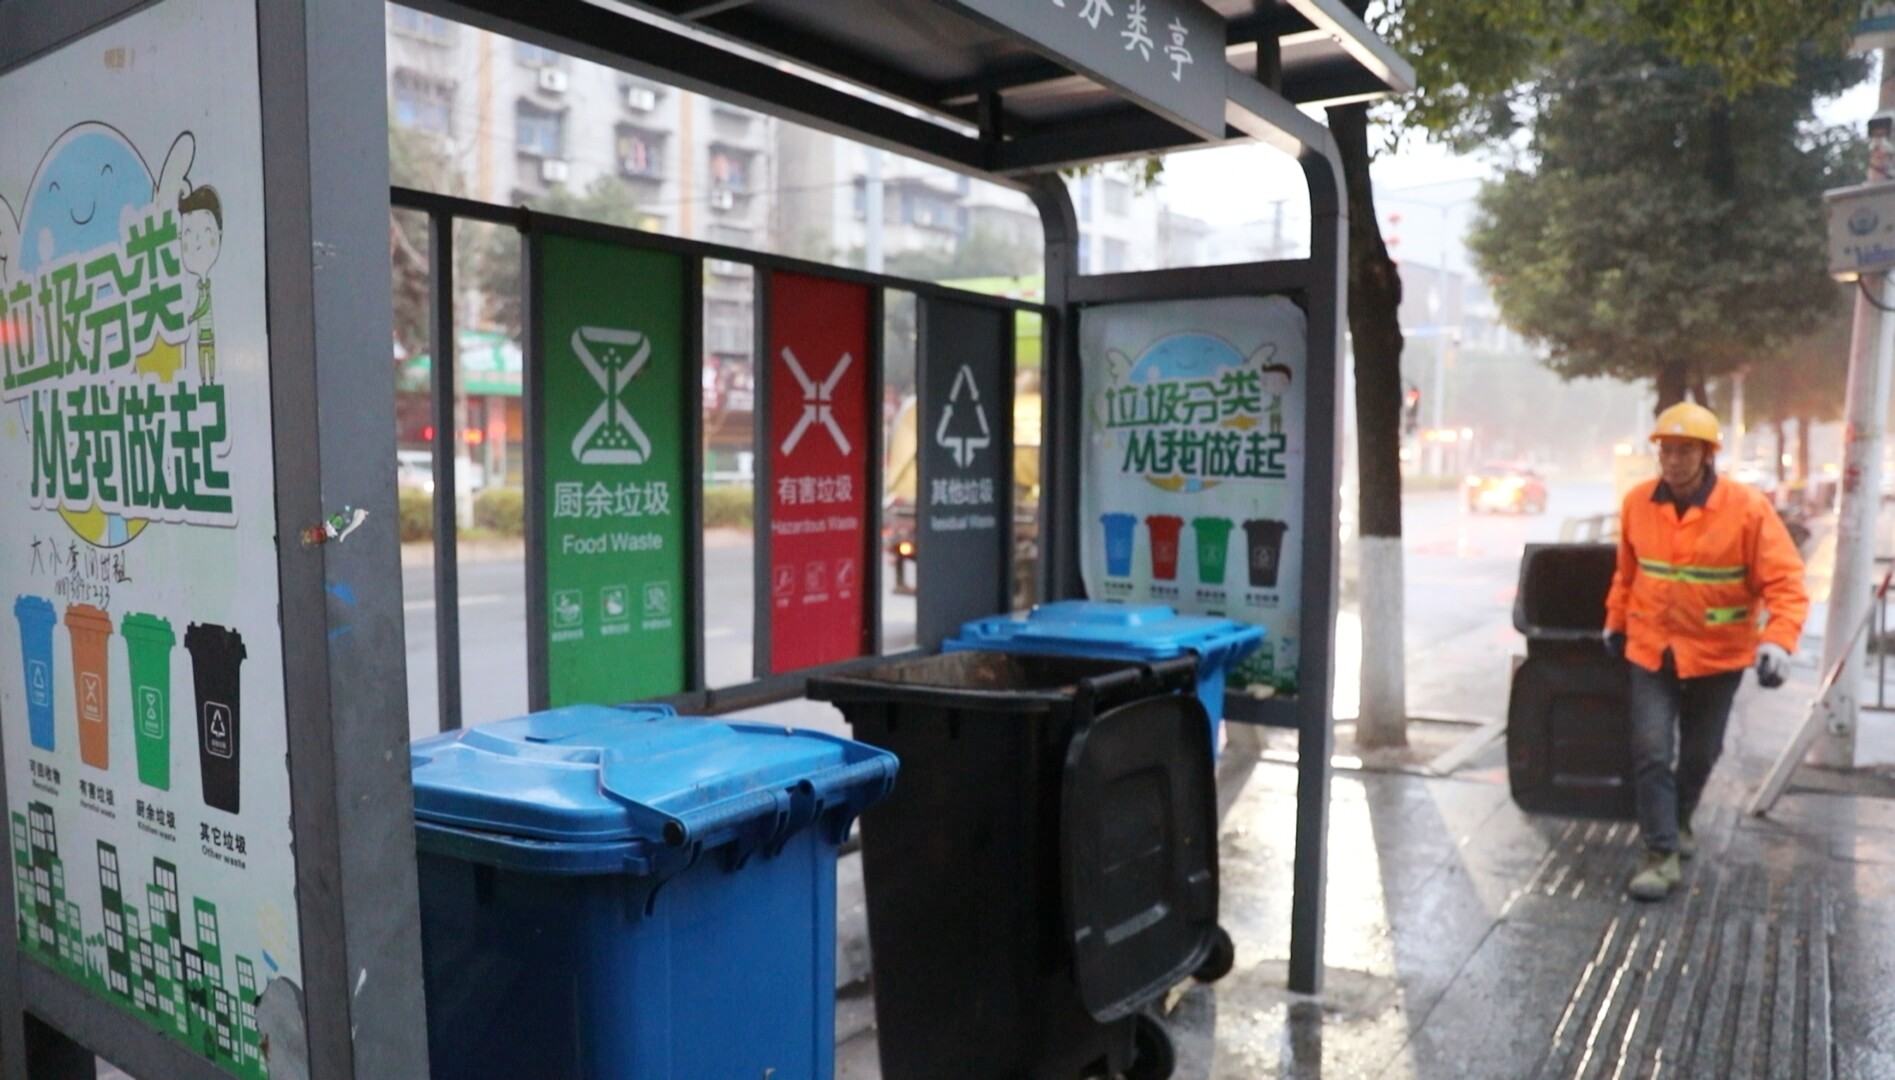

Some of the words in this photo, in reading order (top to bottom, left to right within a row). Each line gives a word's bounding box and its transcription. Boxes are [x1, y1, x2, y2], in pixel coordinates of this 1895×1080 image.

[1053, 0, 1194, 83] 类亭
[0, 209, 185, 391] 垃圾分类
[1105, 369, 1261, 429] 垃圾分类
[31, 381, 233, 513] 从我做起
[553, 481, 670, 518] 厨余垃圾
[778, 475, 852, 505] 有害垃圾
[931, 478, 994, 506] 其他垃圾
[562, 534, 606, 555] Food
[611, 532, 663, 552] Waste
[79, 779, 115, 806] 有害垃圾
[136, 799, 176, 830] 厨余垃圾
[200, 822, 248, 856] 其它垃圾
[201, 844, 222, 861] Other
[223, 855, 246, 870] waste
